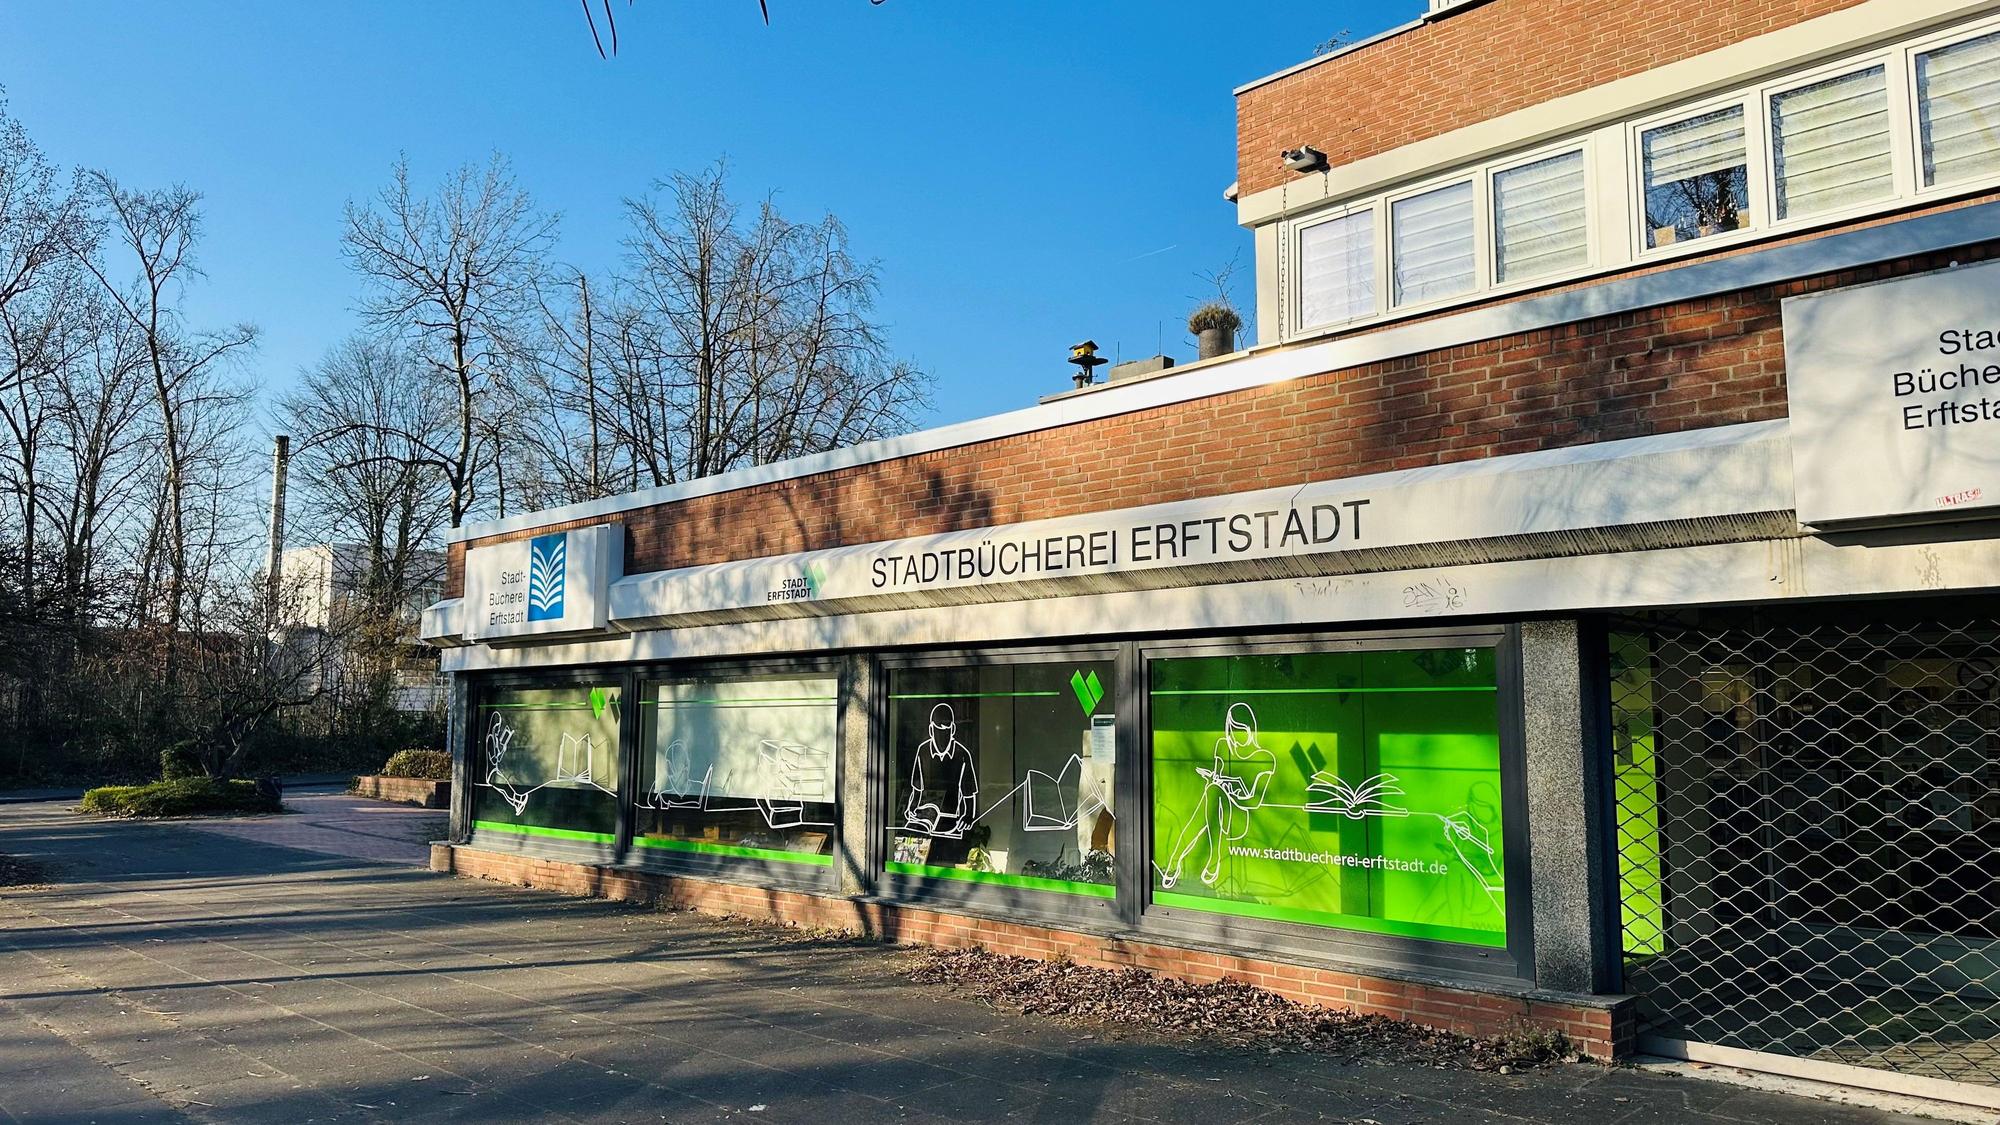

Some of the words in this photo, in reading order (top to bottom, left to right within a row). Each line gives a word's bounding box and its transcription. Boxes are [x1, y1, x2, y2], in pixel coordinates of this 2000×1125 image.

[1939, 329, 2000, 355] Sta
[872, 530, 1117, 589] STADTBÜCHEREI
[1131, 499, 1371, 562] ERFTSTADT
[501, 570, 526, 585] Stadt-
[782, 577, 808, 590] STADT
[489, 589, 526, 606] Bücherei
[767, 587, 812, 602] ERFTSTADT
[490, 609, 524, 626] Erftstadt
[1228, 845, 1448, 875] www.stadtbuecherei-erftstadt.de
